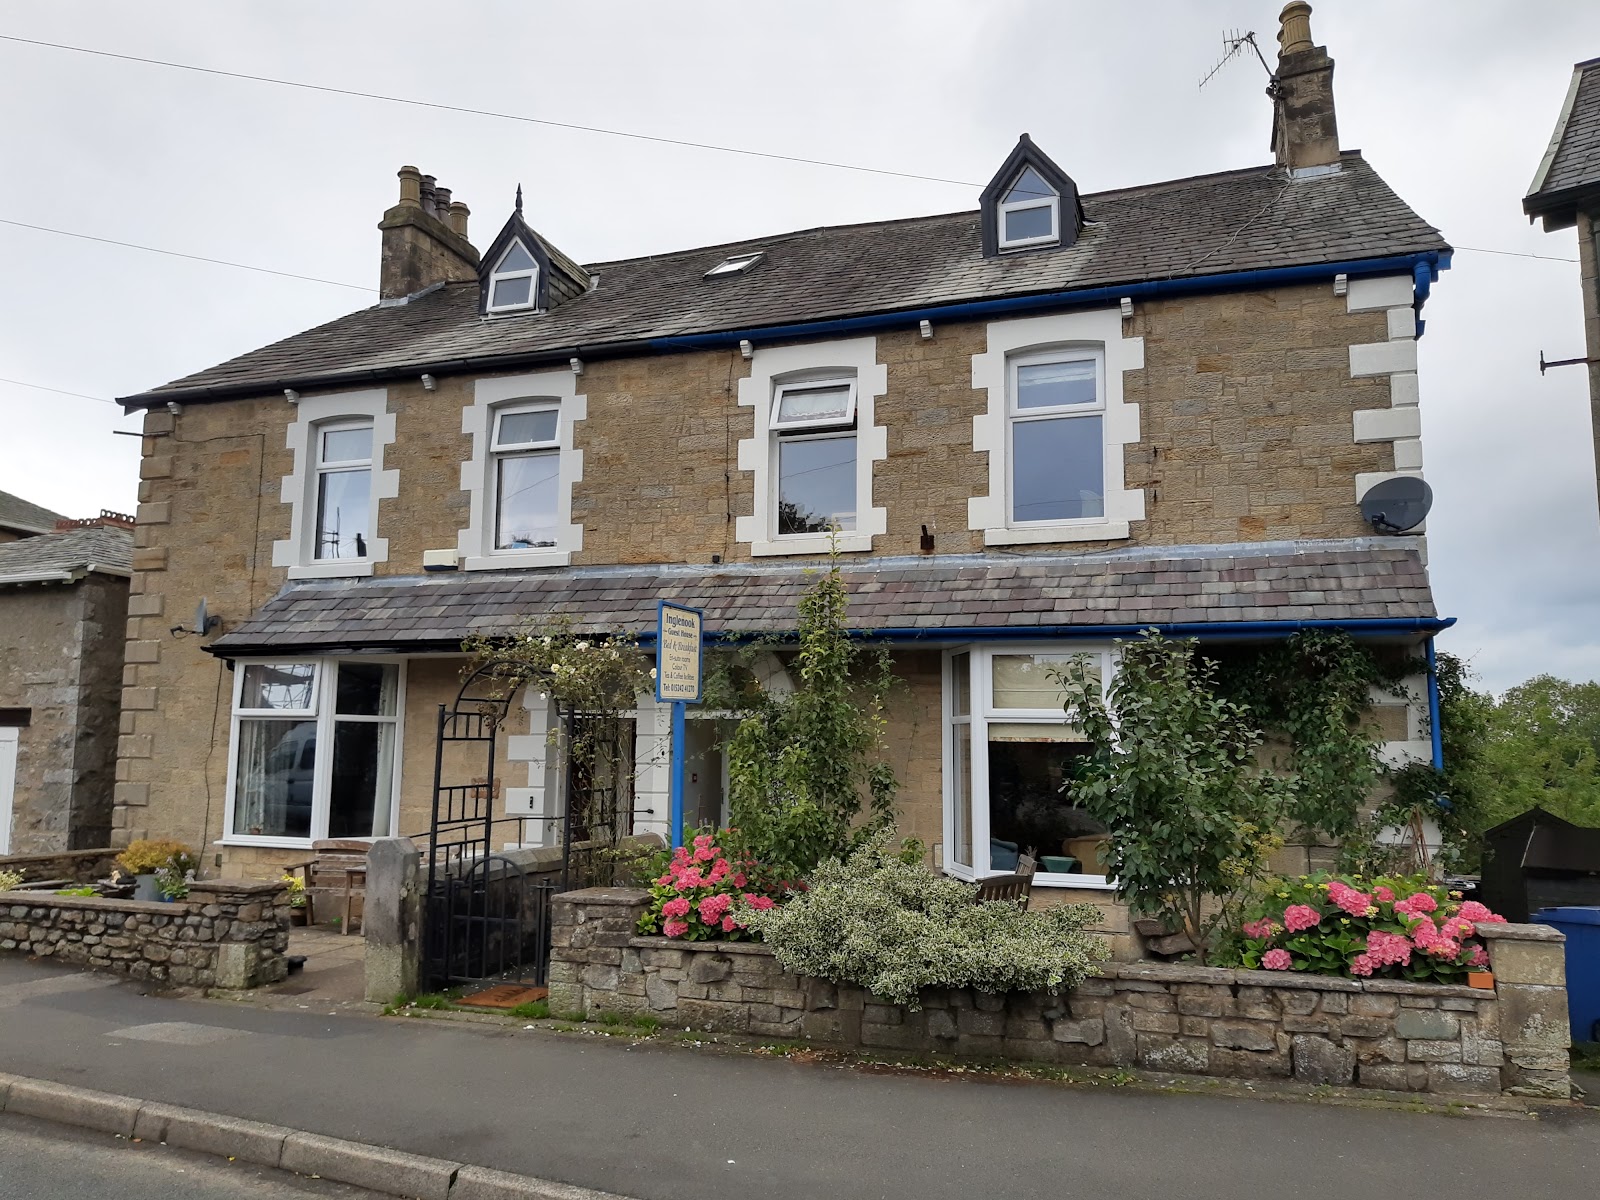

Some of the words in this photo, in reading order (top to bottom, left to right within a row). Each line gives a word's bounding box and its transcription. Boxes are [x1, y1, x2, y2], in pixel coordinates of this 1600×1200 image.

[666, 613, 695, 628] Inglenook
[668, 628, 680, 637] Guest
[681, 630, 693, 639] House
